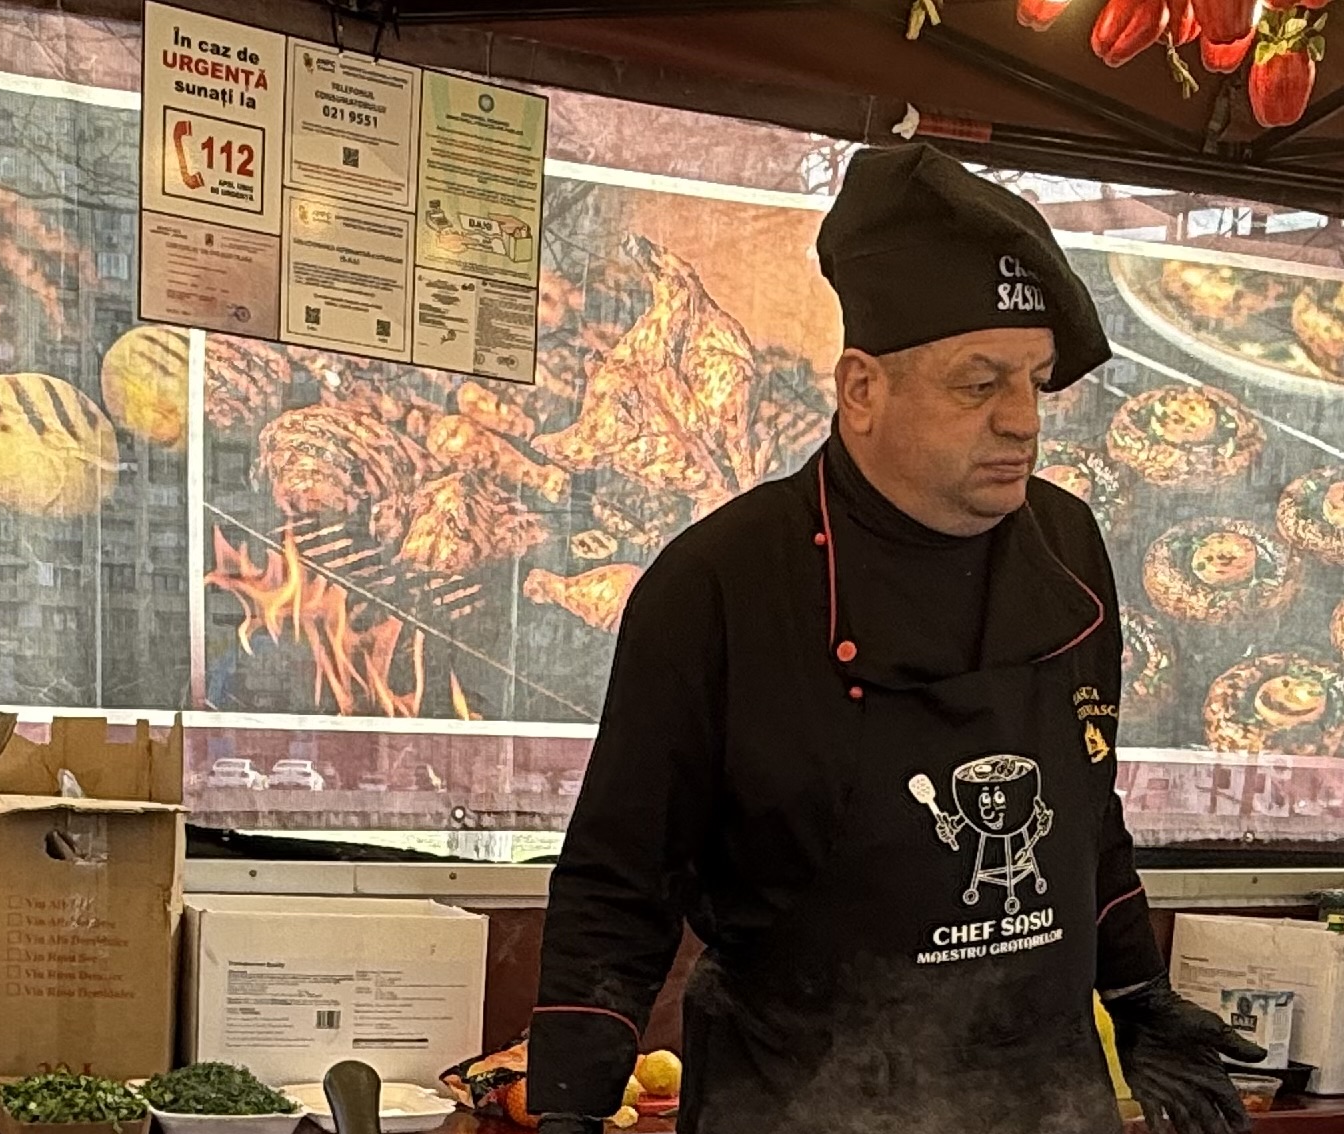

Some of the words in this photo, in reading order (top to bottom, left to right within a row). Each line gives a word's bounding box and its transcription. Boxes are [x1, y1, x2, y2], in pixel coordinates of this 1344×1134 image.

[198, 40, 231, 58] caz
[237, 47, 260, 65] de
[240, 91, 256, 109] la
[322, 105, 344, 121] 021
[348, 109, 378, 128] 9551
[201, 135, 254, 177] 112
[997, 283, 1045, 311] SASU
[933, 920, 997, 946] CHEF
[1001, 907, 1053, 936] SASU
[916, 945, 987, 964] MAESTRU
